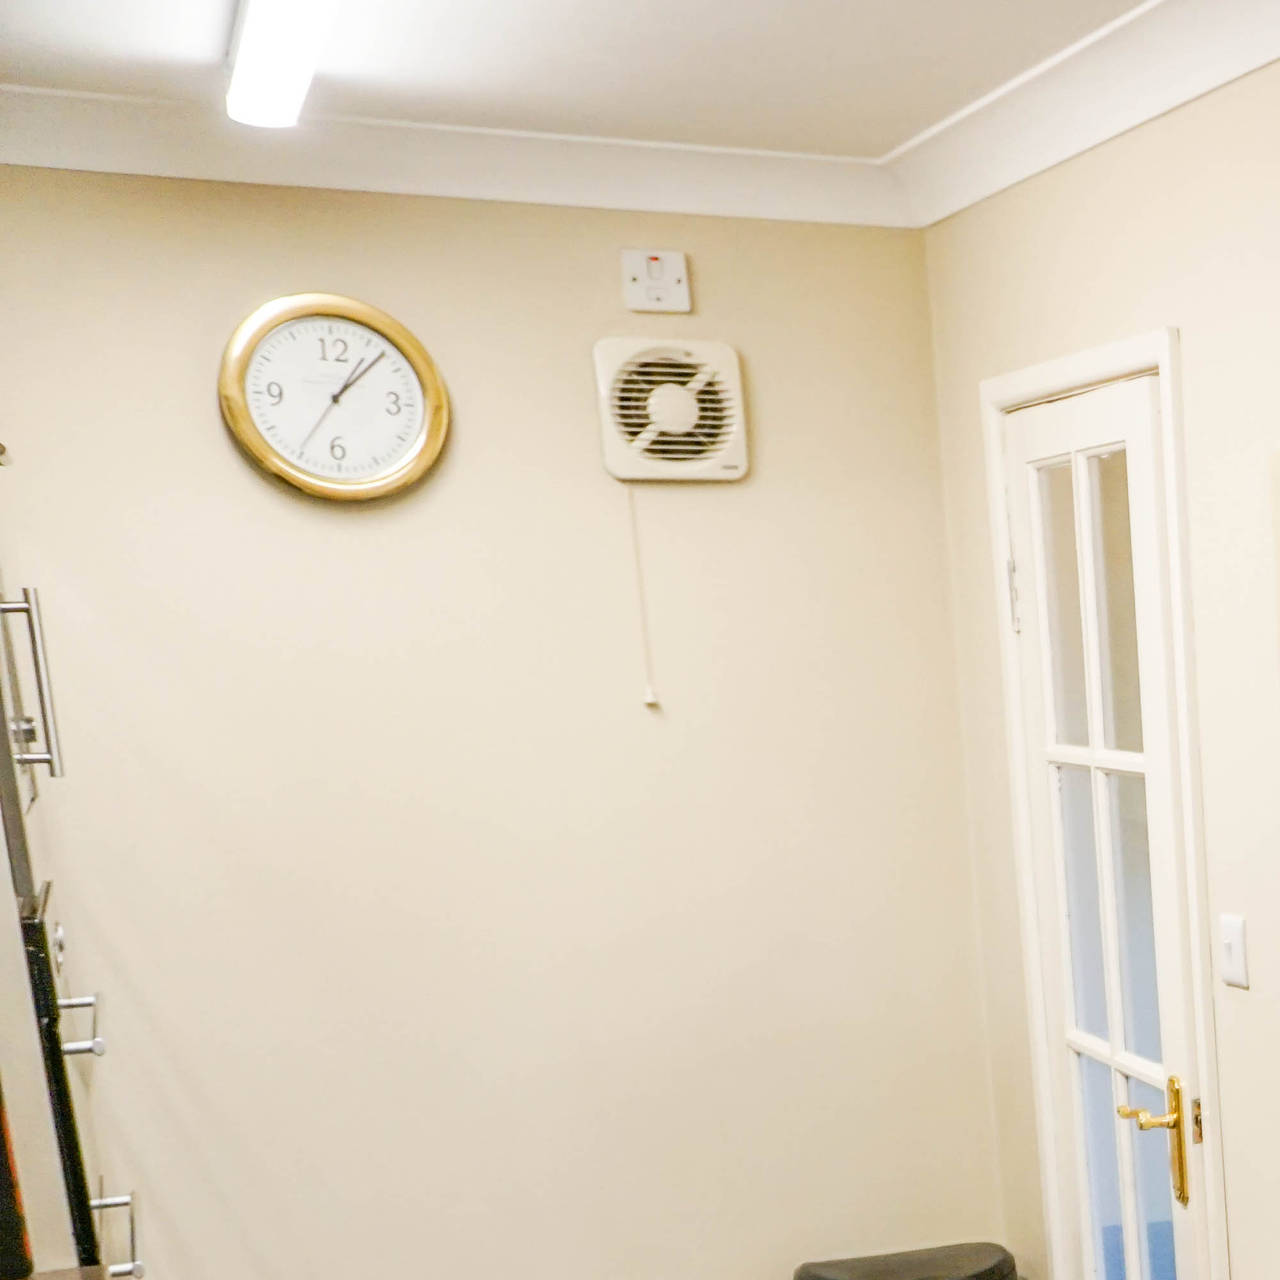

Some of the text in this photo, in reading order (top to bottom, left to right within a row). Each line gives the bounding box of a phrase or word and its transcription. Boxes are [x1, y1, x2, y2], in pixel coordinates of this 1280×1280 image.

[317, 337, 349, 363] 12
[266, 381, 284, 406] 9
[385, 391, 401, 416] 3
[330, 436, 346, 461] 6
